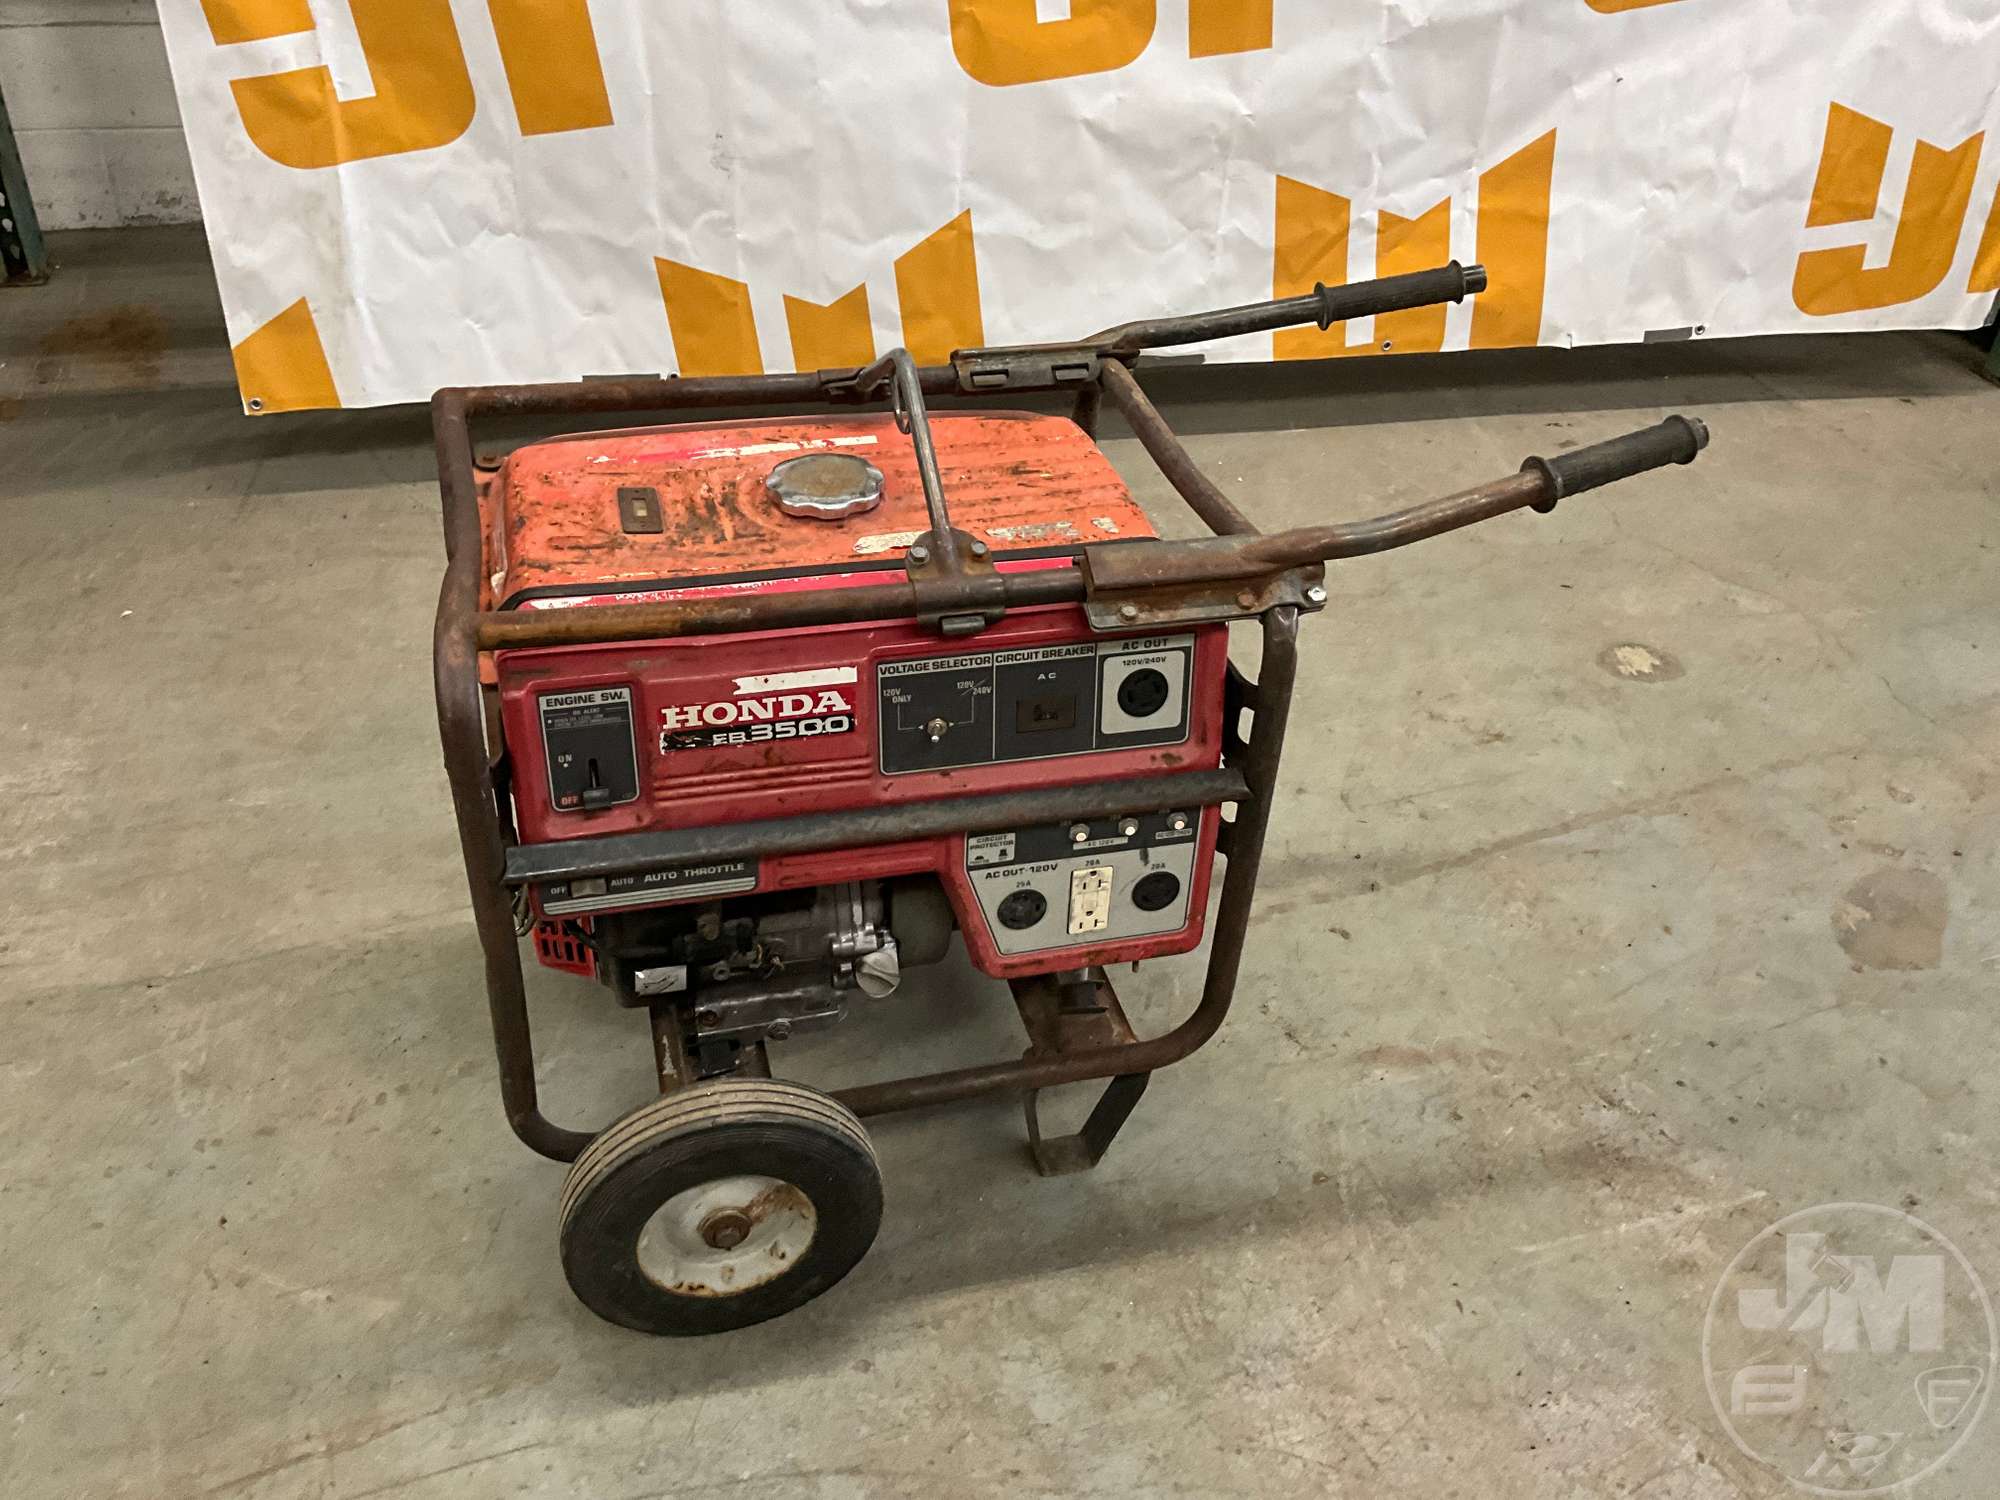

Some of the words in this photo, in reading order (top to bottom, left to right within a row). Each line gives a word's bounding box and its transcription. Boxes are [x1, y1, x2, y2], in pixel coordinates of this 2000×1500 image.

[1122, 640, 1139, 651] AC
[1144, 638, 1169, 648] OUT
[995, 650, 1039, 664] CIRCUIT
[1042, 646, 1095, 660] BREAKER
[880, 663, 931, 676] VOLTAGE
[932, 656, 992, 670] SELECTOR
[545, 693, 596, 707] ENGINE
[661, 690, 851, 730] HONDA
[558, 753, 573, 763] ON
[561, 795, 578, 806] OFF
[645, 870, 677, 883] AUTO
[683, 862, 745, 877] THROTTLE
[985, 870, 1001, 880] AC
[610, 877, 634, 887] AUTO
[550, 885, 567, 895] OFF
